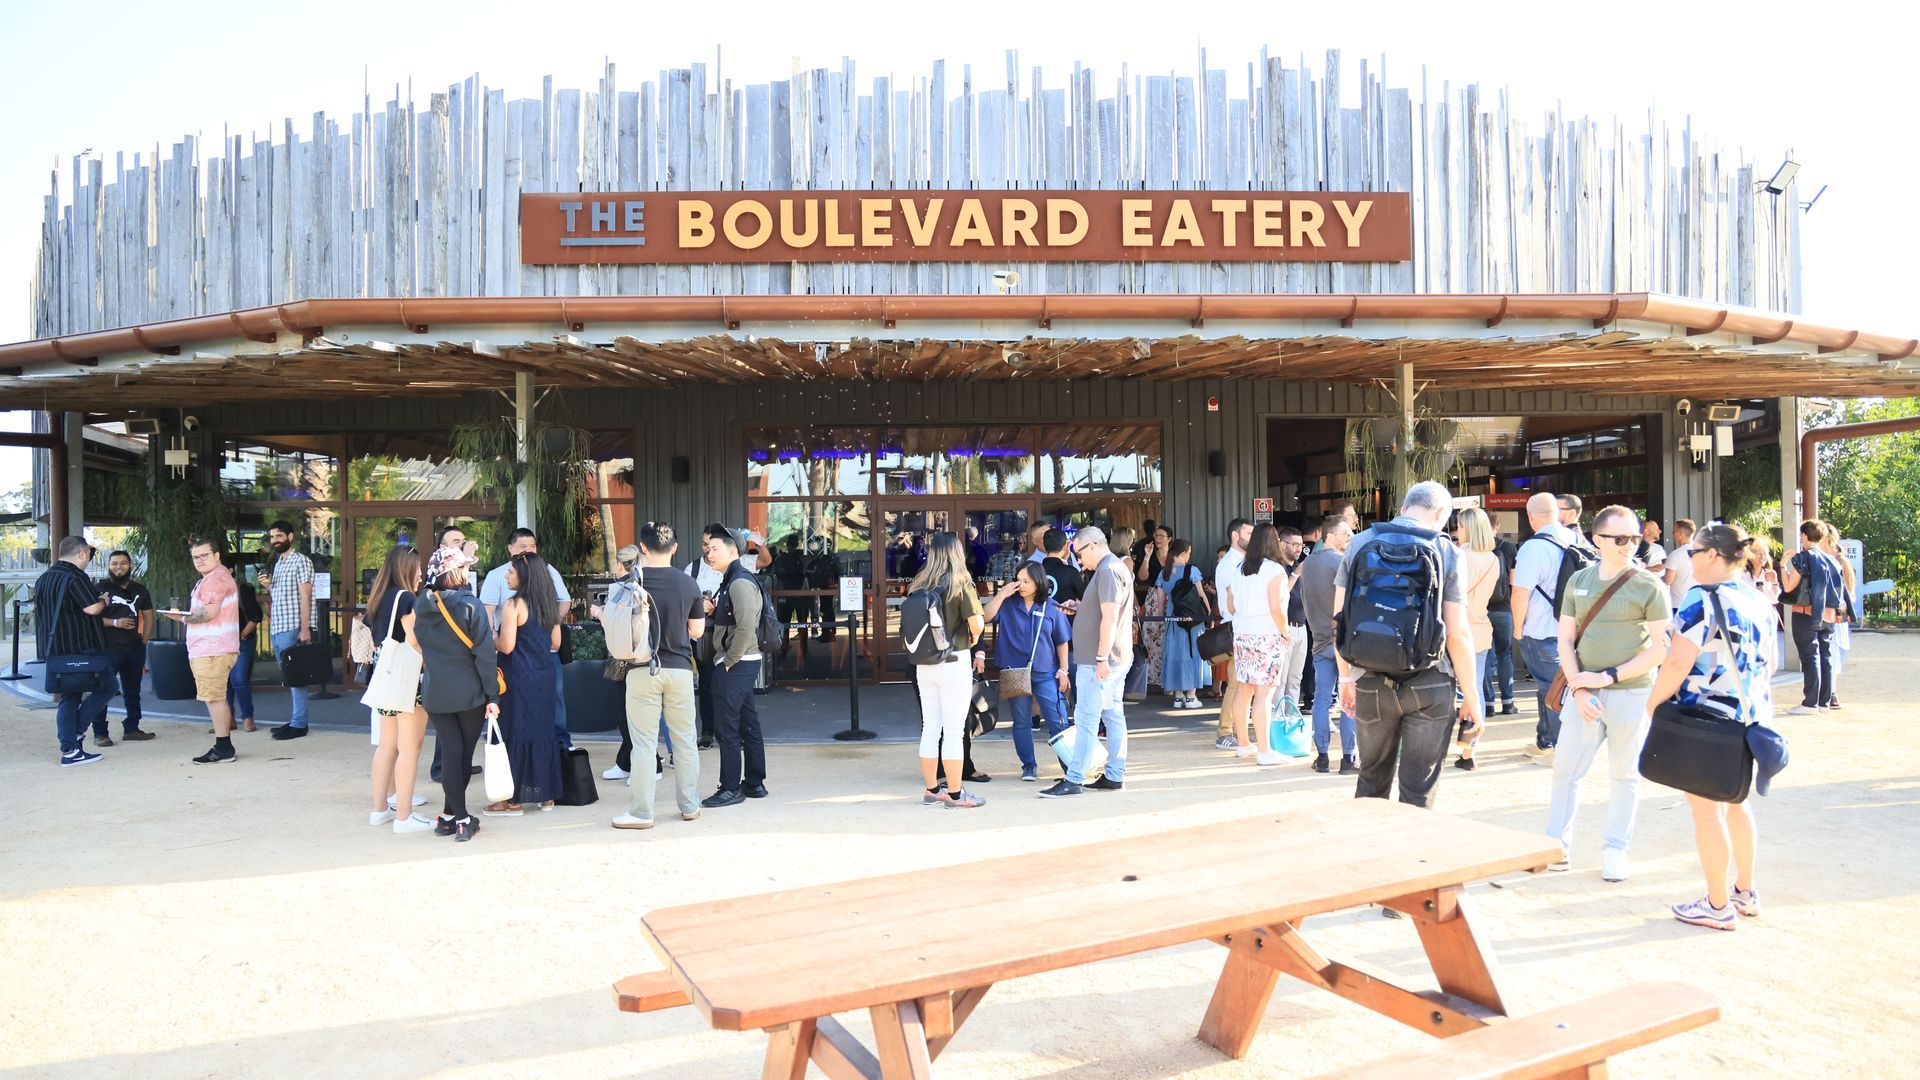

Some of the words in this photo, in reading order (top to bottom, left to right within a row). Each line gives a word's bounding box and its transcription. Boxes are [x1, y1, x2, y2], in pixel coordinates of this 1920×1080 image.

[560, 201, 645, 231] THE
[678, 199, 1089, 249] BOULEVARD
[1122, 199, 1374, 248] EATERY
